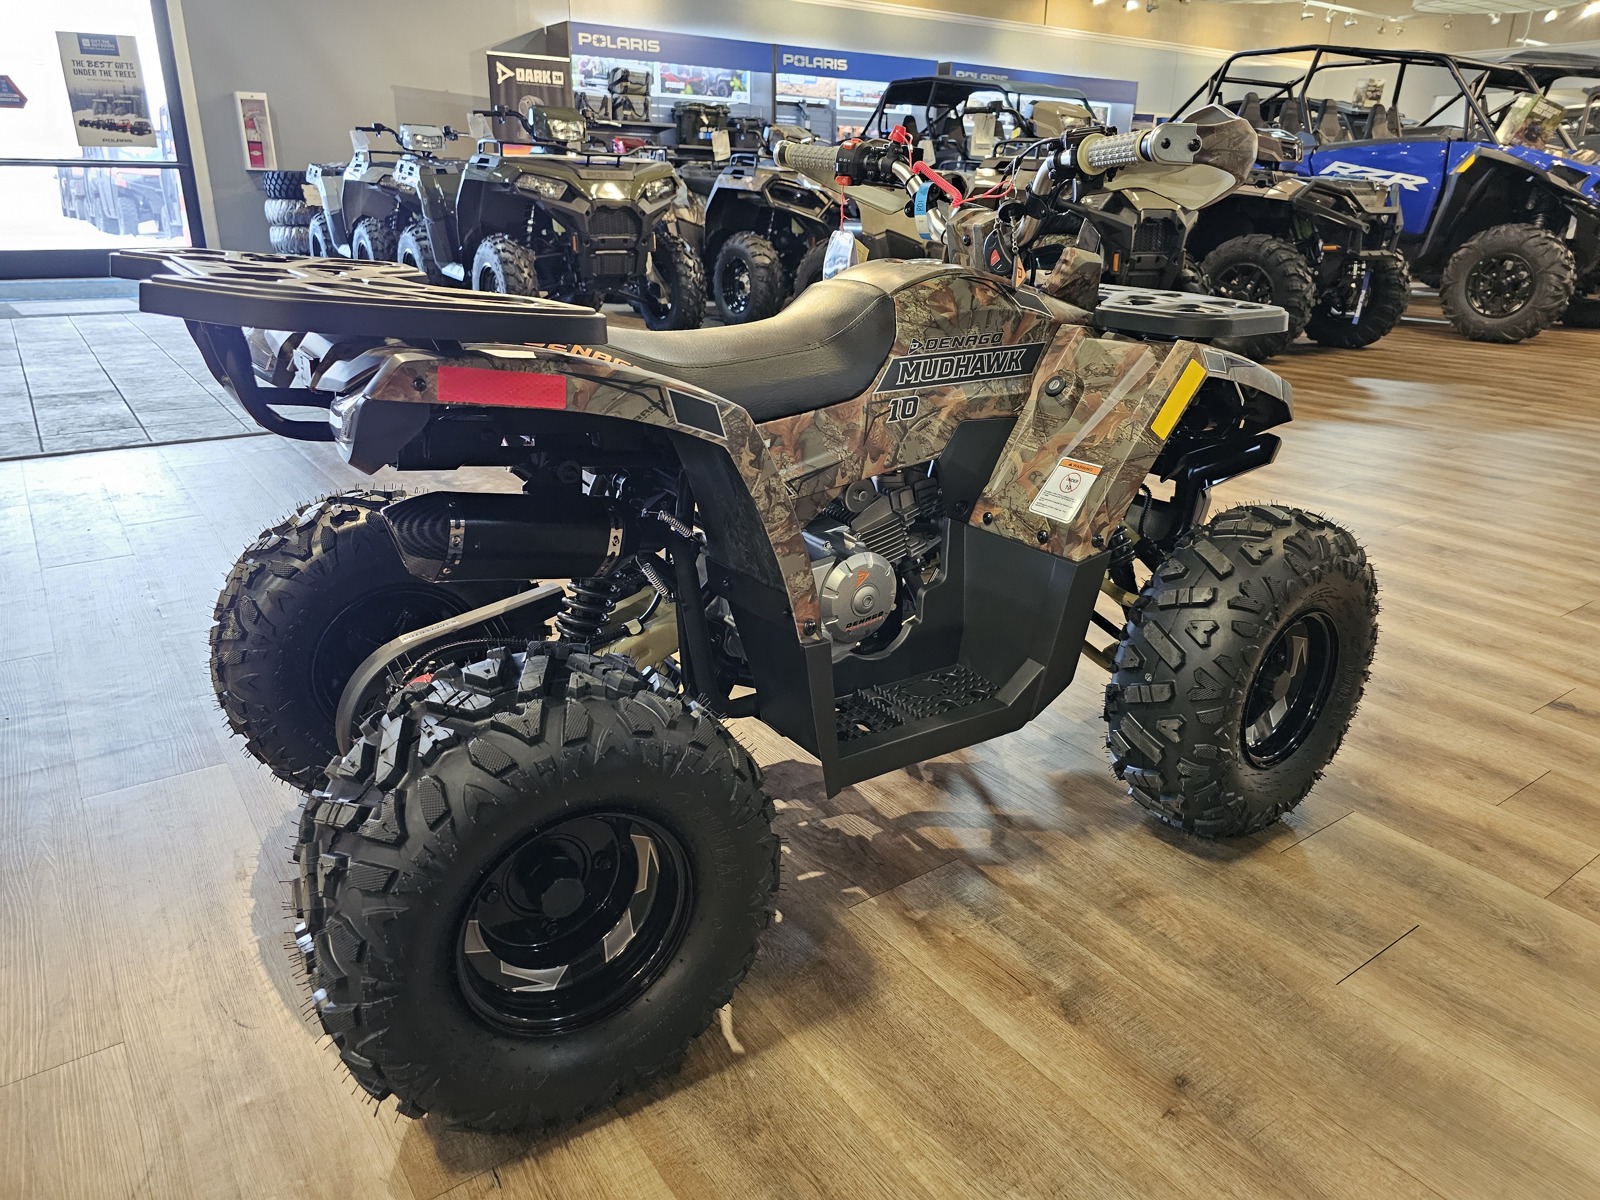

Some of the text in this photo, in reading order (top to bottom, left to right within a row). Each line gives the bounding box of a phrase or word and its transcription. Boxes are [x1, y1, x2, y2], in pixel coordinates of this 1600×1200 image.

[578, 32, 660, 53] POLARIS
[71, 60, 135, 70] THE BEST GIFTS
[782, 53, 849, 71] POLARIS
[73, 69, 137, 79] UNDER THE TREES
[1318, 160, 1430, 192] RZR
[925, 332, 1004, 350] DENAGO
[896, 348, 1027, 386] MUDHAWK
[886, 395, 920, 424] 10
[845, 611, 885, 629] DENAGO
